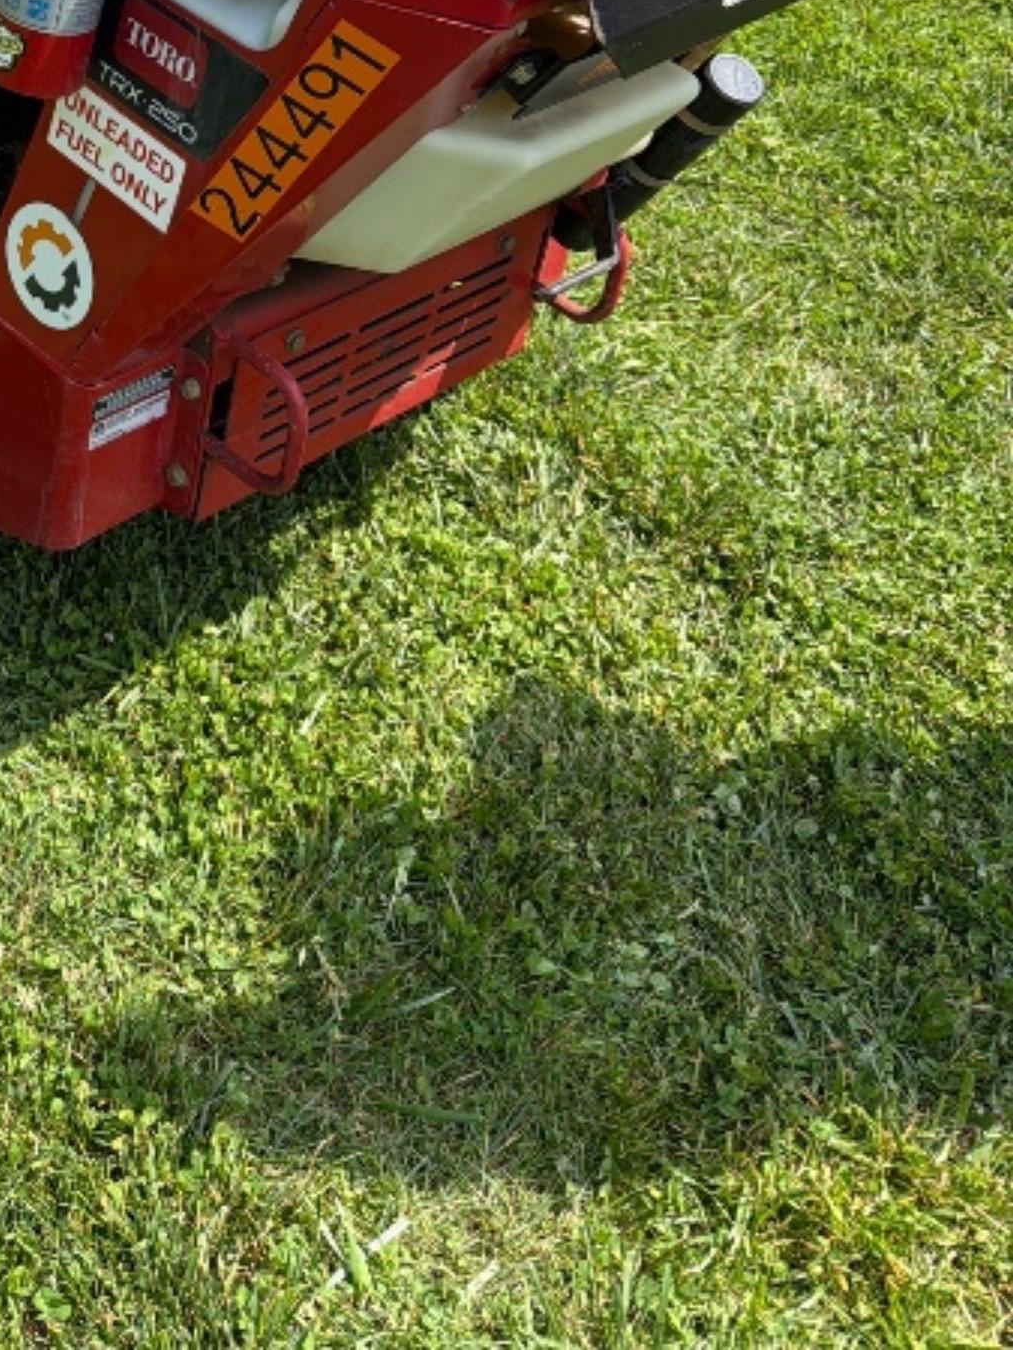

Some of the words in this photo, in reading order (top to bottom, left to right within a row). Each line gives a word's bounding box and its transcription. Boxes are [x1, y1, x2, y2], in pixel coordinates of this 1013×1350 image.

[126, 17, 196, 82] TORO
[55, 119, 105, 172] FUEL
[110, 161, 168, 216] ONLY
[64, 92, 174, 183] UNLEADED
[199, 34, 386, 236] 244491
